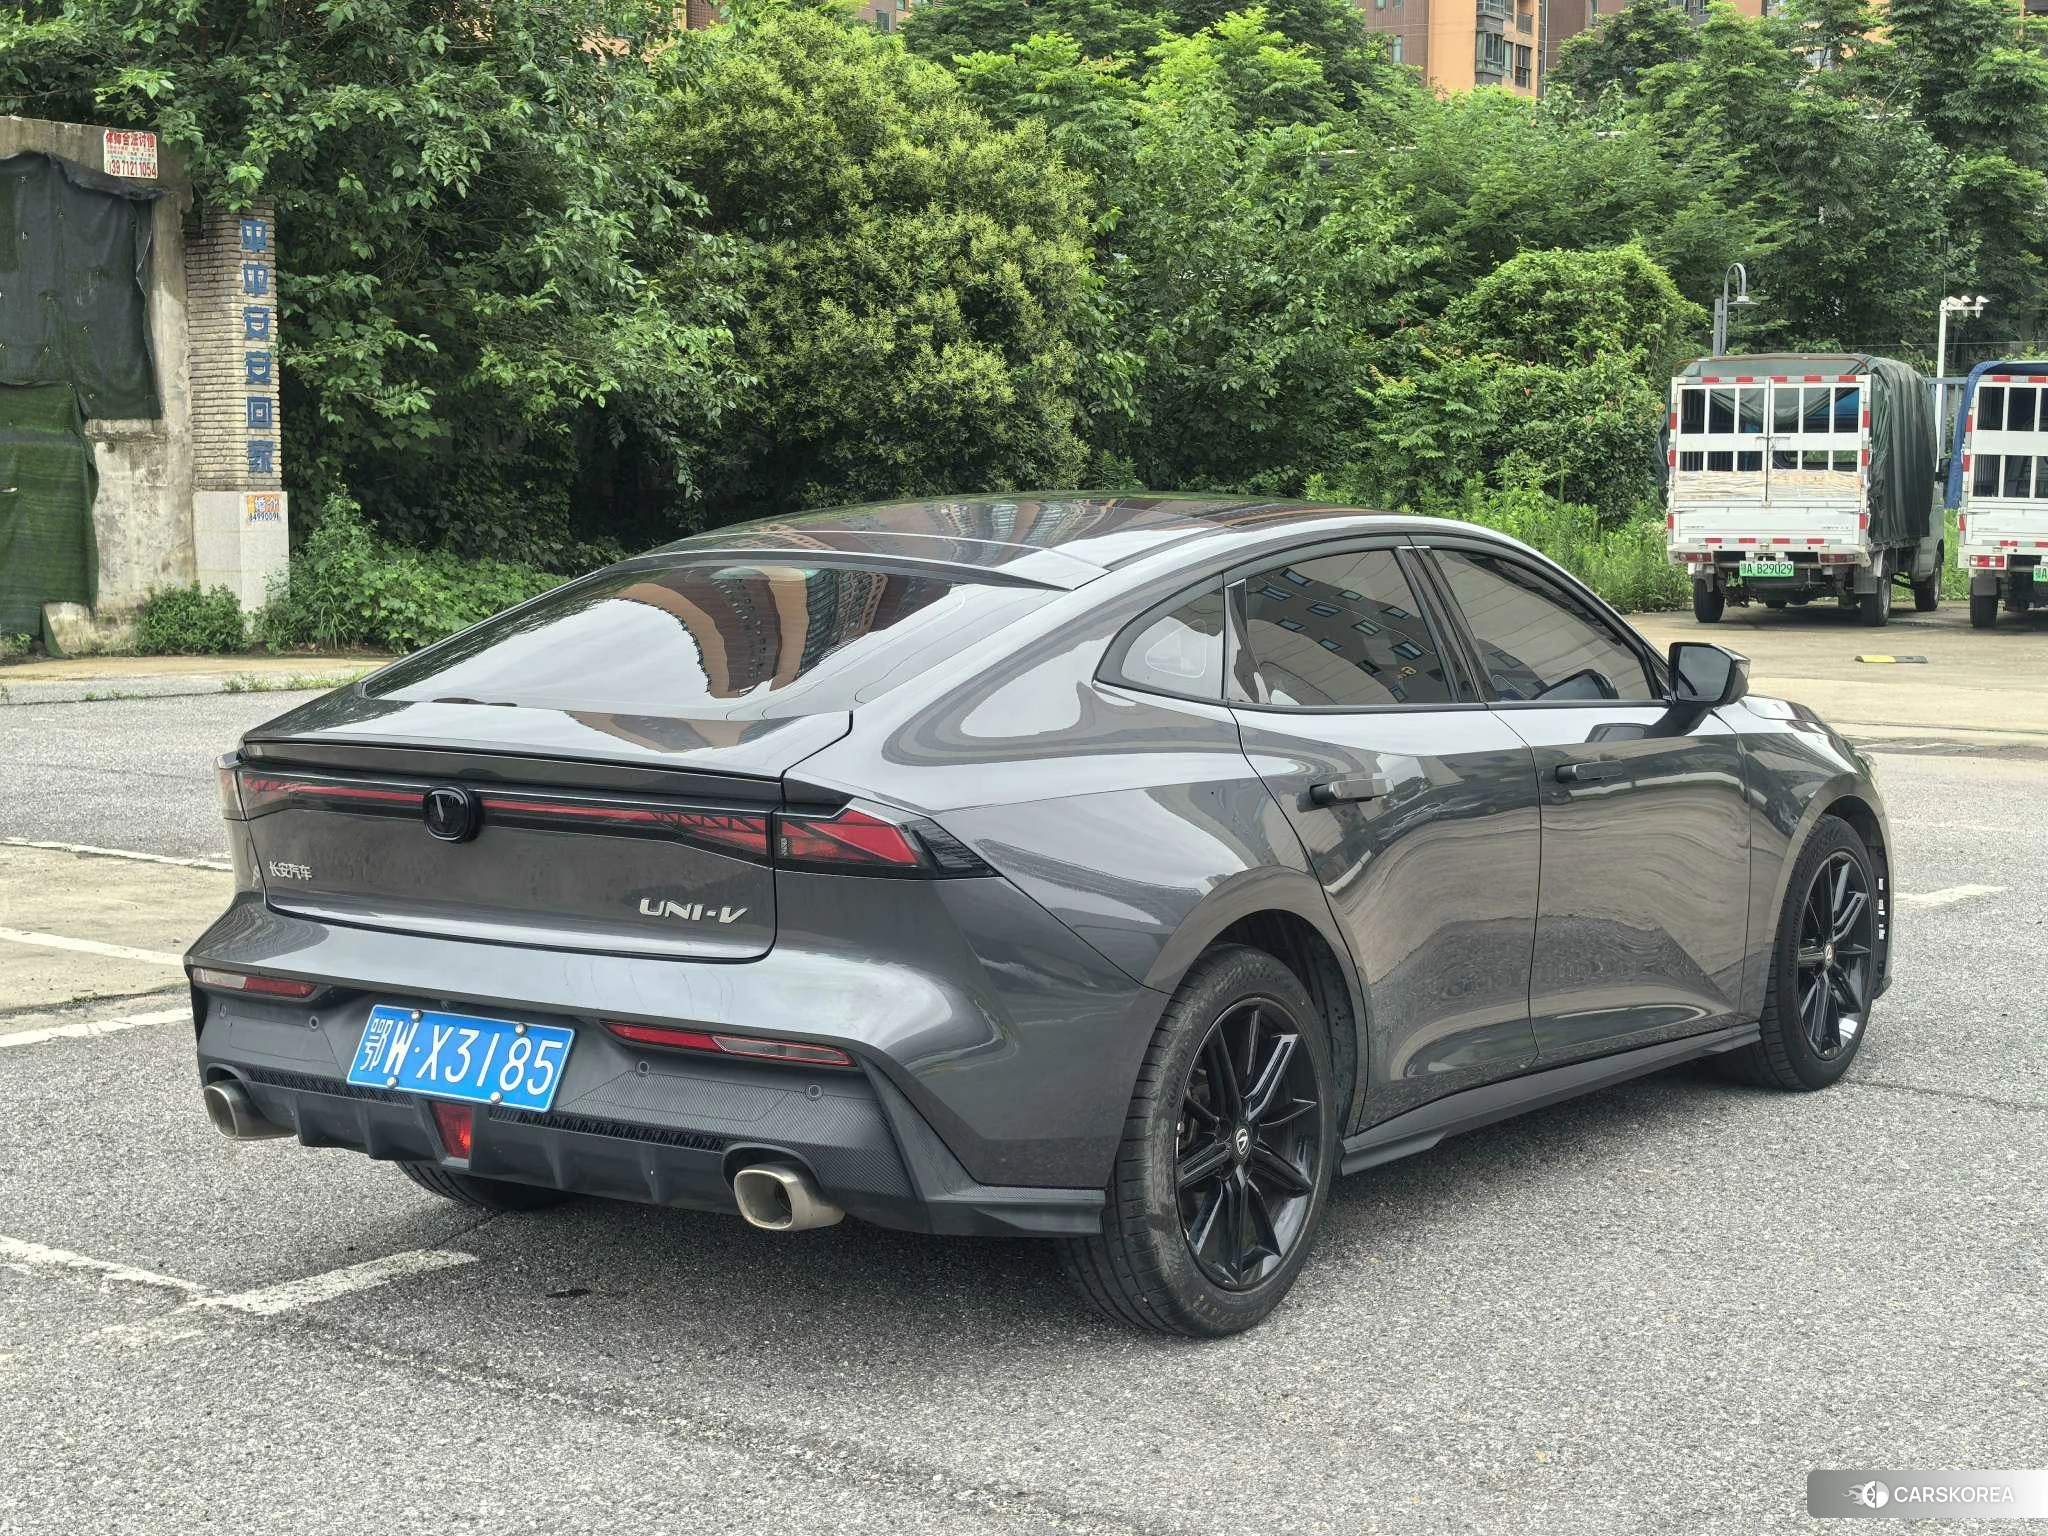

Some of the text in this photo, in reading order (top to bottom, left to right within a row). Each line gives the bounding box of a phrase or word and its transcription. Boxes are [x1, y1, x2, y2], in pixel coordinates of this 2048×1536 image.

[240, 219, 274, 473] 平平安安回家
[269, 860, 313, 880] 长安汽车
[639, 898, 748, 924] UNI-V
